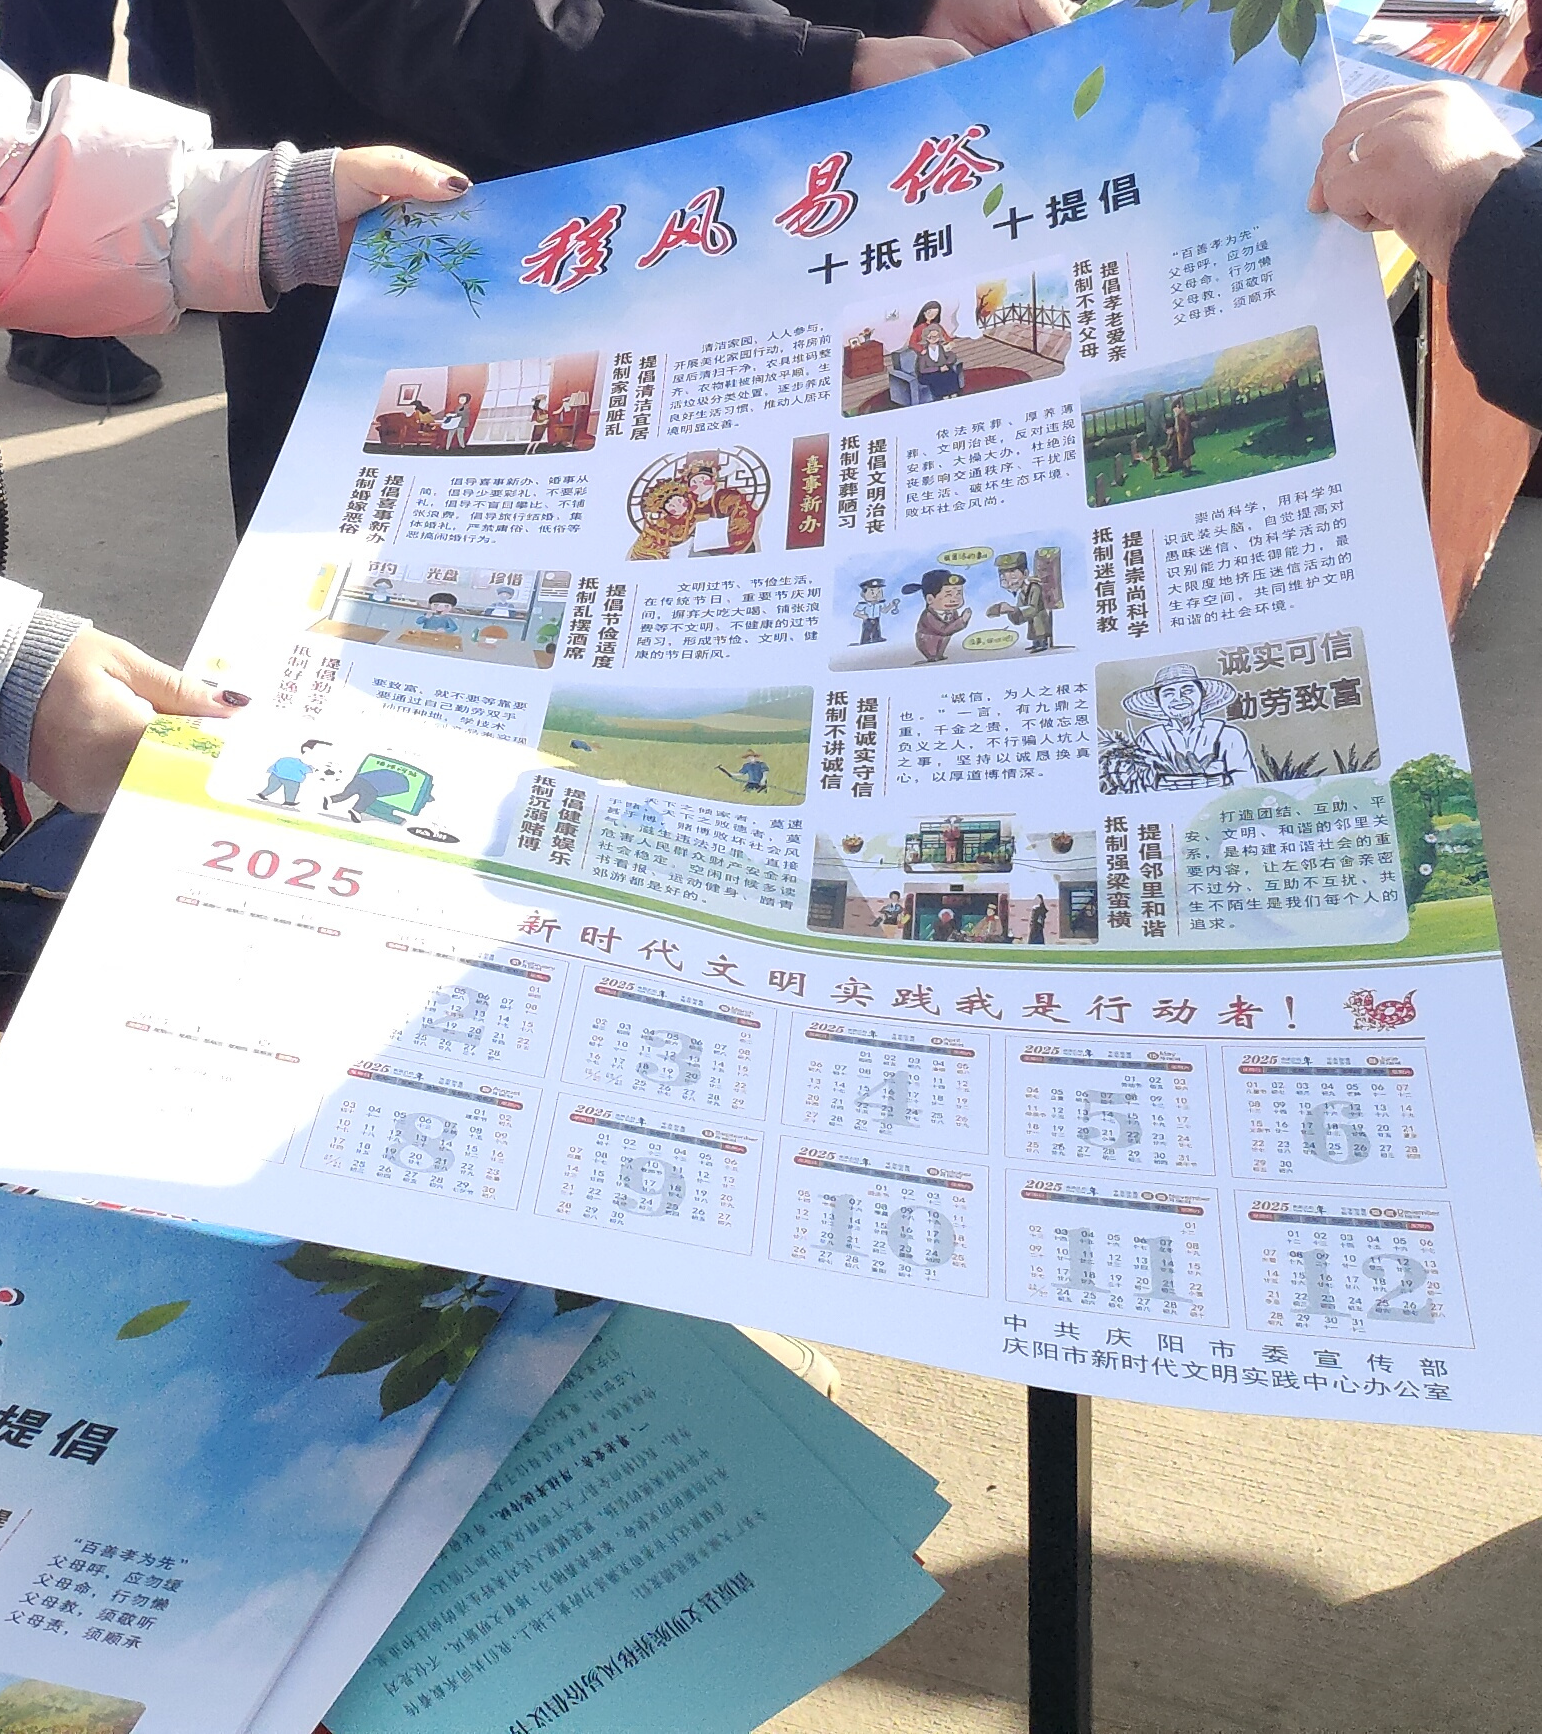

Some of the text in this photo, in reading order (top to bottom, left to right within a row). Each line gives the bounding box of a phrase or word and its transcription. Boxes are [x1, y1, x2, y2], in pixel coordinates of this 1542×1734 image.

[520, 123, 1003, 293] 移风易俗
[807, 171, 1143, 284] 十抵制 十提倡
[1073, 258, 1099, 358] 抵制不孝父母
[1100, 260, 1127, 363] 提倡孝老爱亲
[605, 352, 632, 437] 抵制家园脏乱
[630, 355, 657, 440] 提倡清洁宜居
[667, 420, 739, 435] 境明显改善。
[339, 467, 379, 535] 抵制婚嫁恶俗
[366, 474, 405, 544] 提倡喜事新办
[798, 454, 823, 533] 喜事新办
[838, 435, 860, 529] 抵制丧葬陋习
[865, 438, 887, 534] 提倡文明治丧
[427, 567, 459, 584] 光盘
[489, 571, 524, 586] 珍惜
[1091, 527, 1118, 634] 抵制迷信邪教
[1122, 531, 1149, 638] 提倡崇尚科学
[563, 577, 599, 660] 抵制乱摆酒席
[592, 584, 627, 668] 提倡节俭适度
[1170, 602, 1295, 628] 和谐的社会环境。
[1217, 630, 1353, 677] 诚实可信
[821, 691, 849, 790] 抵制不讲诚信
[851, 697, 879, 797] 提倡诚实守信
[517, 775, 556, 852] 抵制沉溺赌博
[549, 787, 586, 867] 提倡健康娱乐
[201, 840, 364, 898] 2025
[1104, 816, 1131, 929] 抵制强梁蛮横
[1138, 824, 1166, 937] 提倡邻里和谐
[1190, 918, 1236, 930] 追求。
[516, 909, 1298, 1031] 新时代文明实践我是行动者！
[599, 977, 635, 991] 2025
[809, 1021, 845, 1036] 2025
[1025, 1044, 1060, 1056] 2025
[1241, 1053, 1277, 1066] 2025
[575, 1105, 612, 1118] 2025
[799, 1147, 835, 1162] 2025
[1024, 1180, 1063, 1192] 2025
[1250, 1200, 1290, 1213] 2025
[1001, 1337, 1454, 1402] 庆阳市新时代文明实践中心办公室
[1003, 1314, 1447, 1377] 中共庆阳市委宣传部
